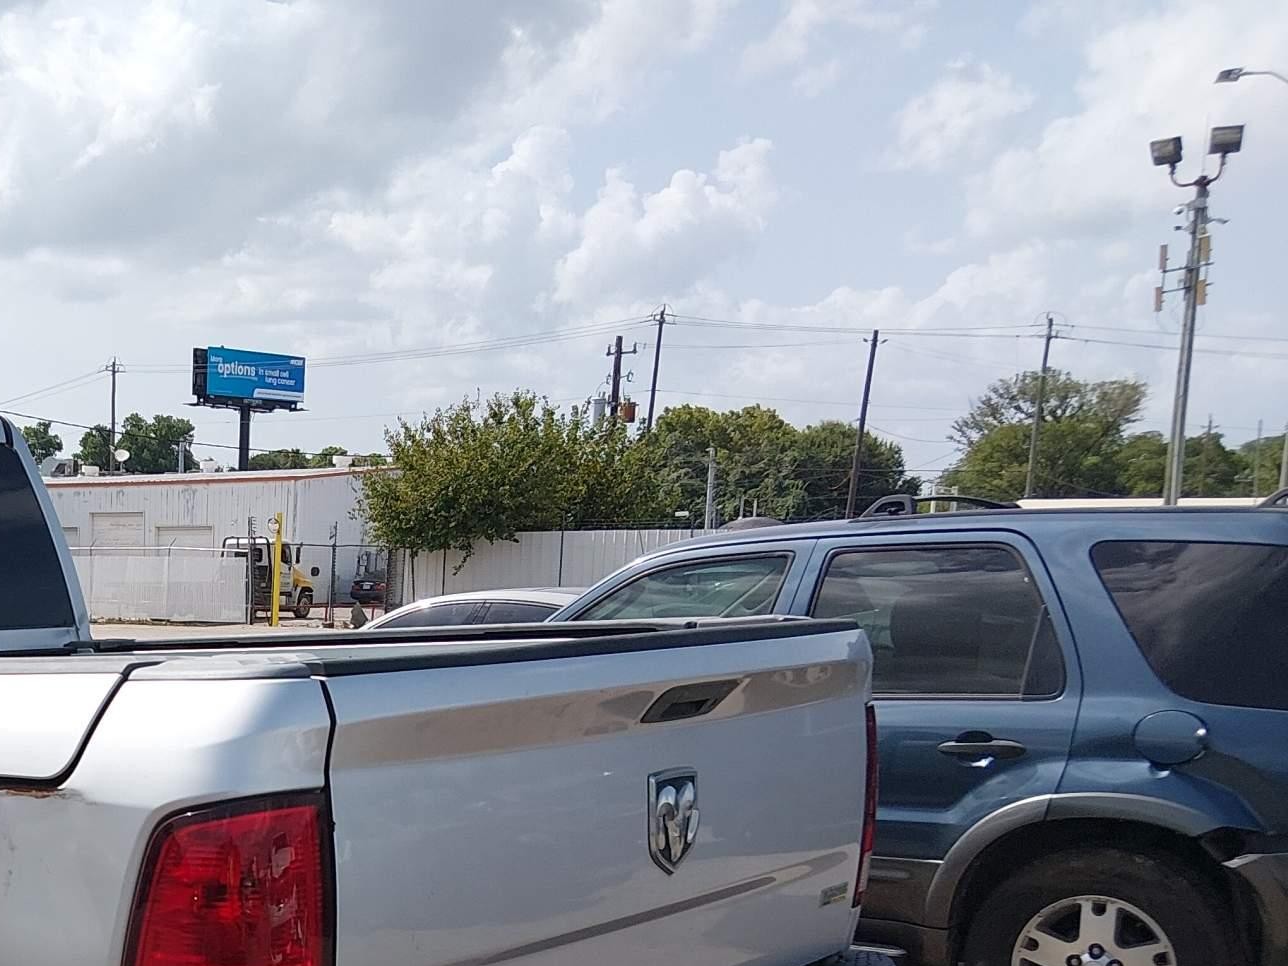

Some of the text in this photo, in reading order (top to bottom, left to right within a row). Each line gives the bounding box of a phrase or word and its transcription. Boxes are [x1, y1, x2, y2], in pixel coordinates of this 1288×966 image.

[217, 361, 256, 378] options
[265, 377, 295, 386] lung cancer
